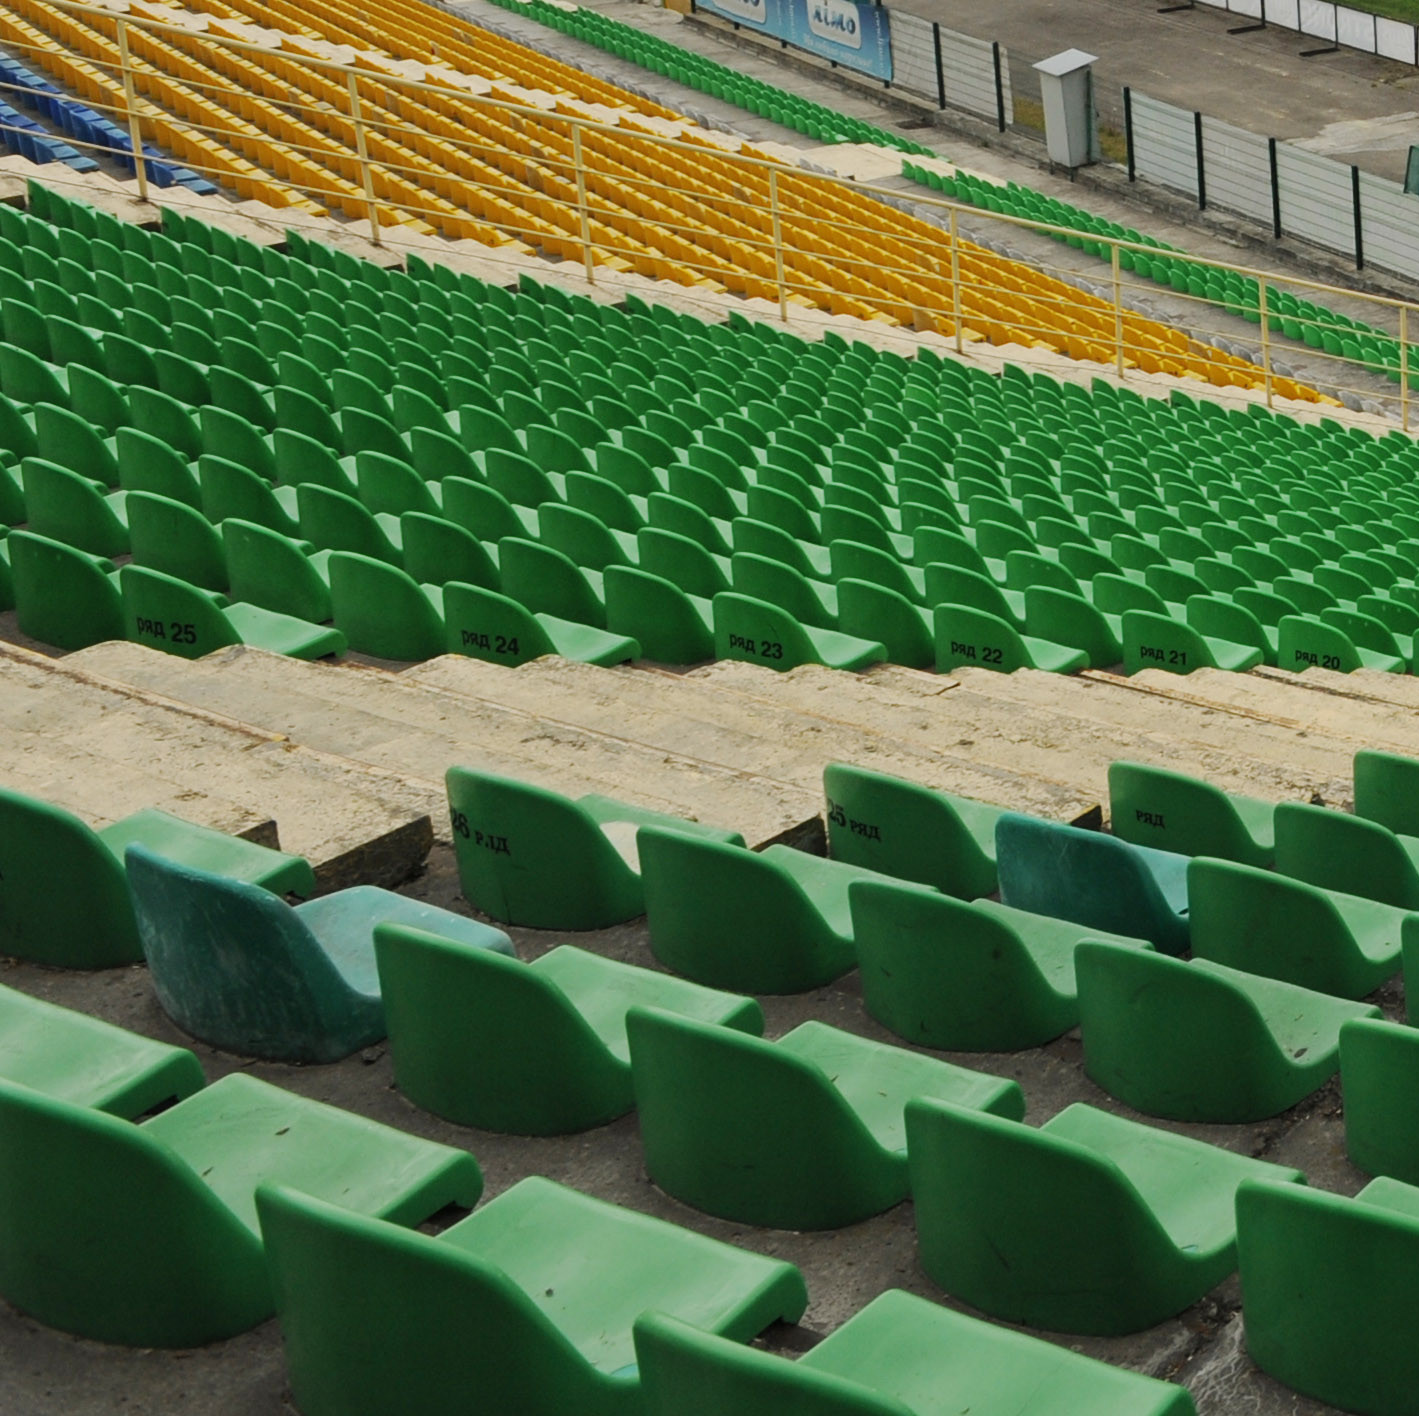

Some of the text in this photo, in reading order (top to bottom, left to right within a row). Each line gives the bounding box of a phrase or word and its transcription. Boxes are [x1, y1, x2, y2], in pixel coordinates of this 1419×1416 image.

[136, 616, 197, 645] ряд 25
[461, 629, 521, 655] ряд 24
[729, 633, 784, 660] ряд 23
[950, 641, 1003, 665] ряд 22
[1140, 644, 1187, 667] ряд 21
[1294, 649, 1341, 671] ряд 20
[451, 807, 470, 839] 26
[828, 797, 882, 843] 25 РЯД
[1135, 809, 1165, 829] РЯД
